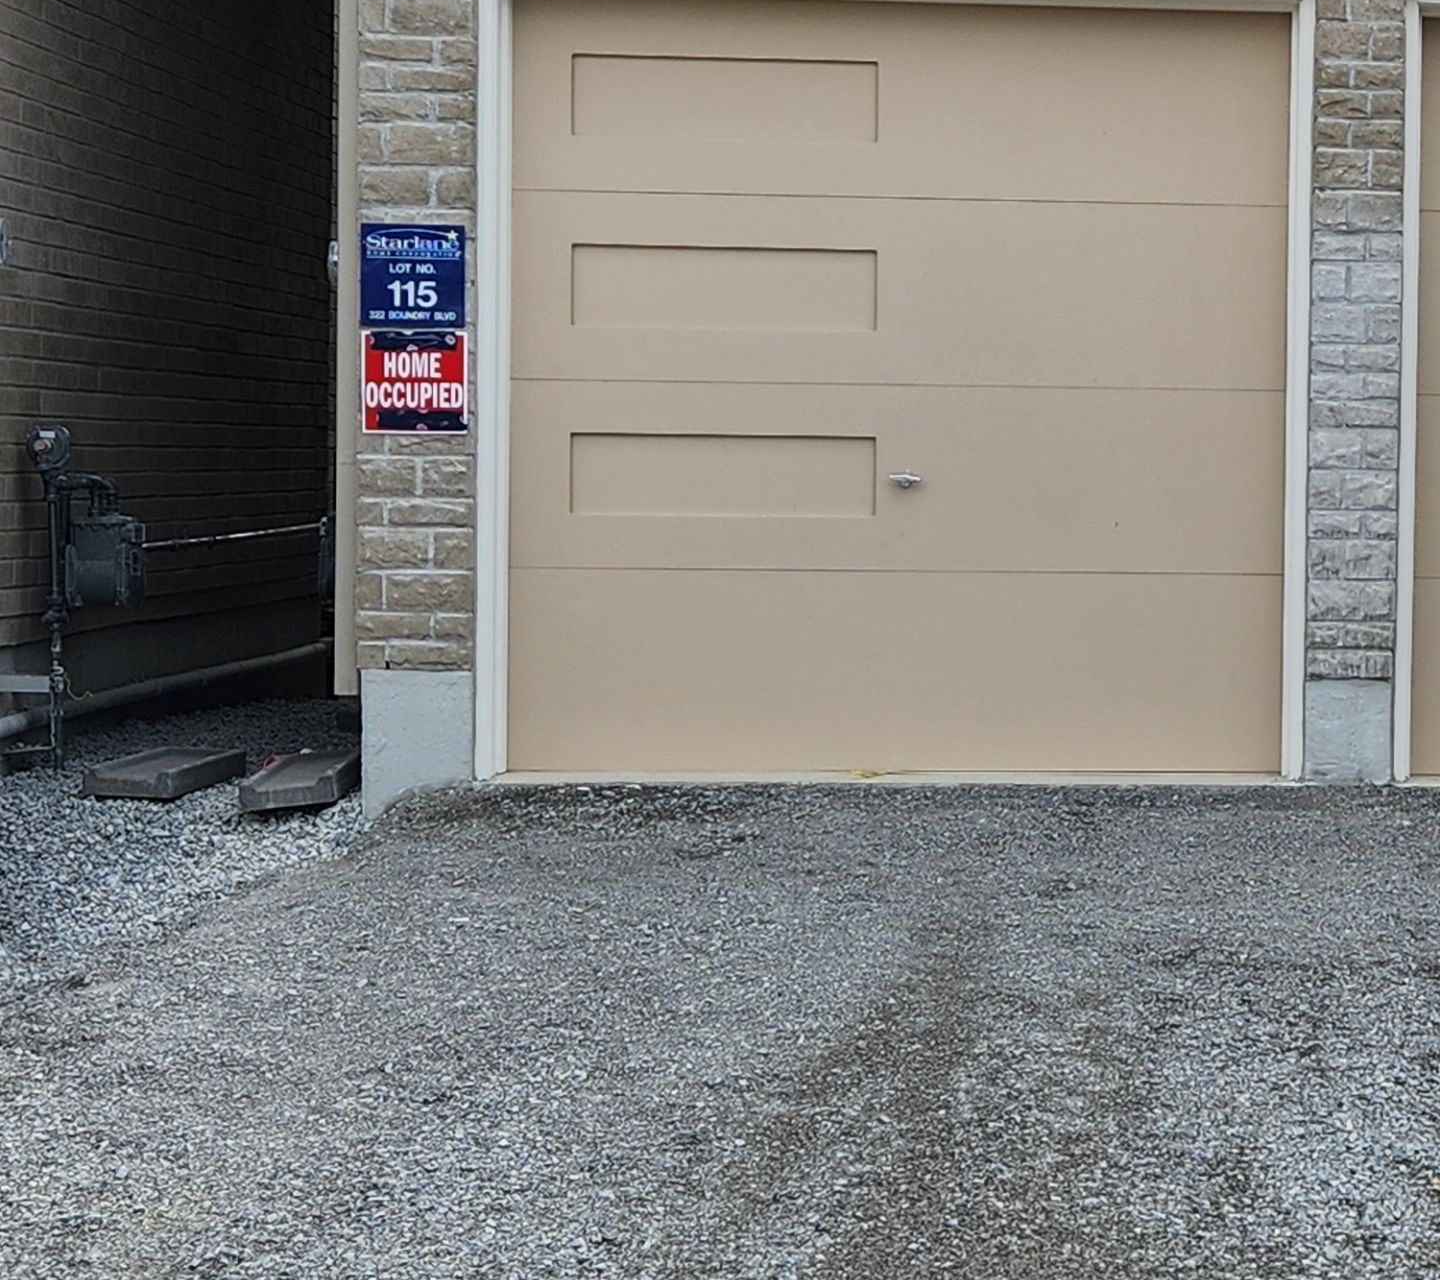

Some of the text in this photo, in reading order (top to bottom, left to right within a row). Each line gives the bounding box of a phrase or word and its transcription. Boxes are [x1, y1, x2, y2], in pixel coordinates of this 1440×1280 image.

[366, 234, 460, 251] Starlane
[389, 263, 436, 275] LOT NO.
[387, 280, 438, 308] 115
[368, 310, 385, 320] 322
[434, 312, 456, 321] BLVD
[383, 351, 442, 379] HOME
[365, 381, 464, 409] OCCUPIED
